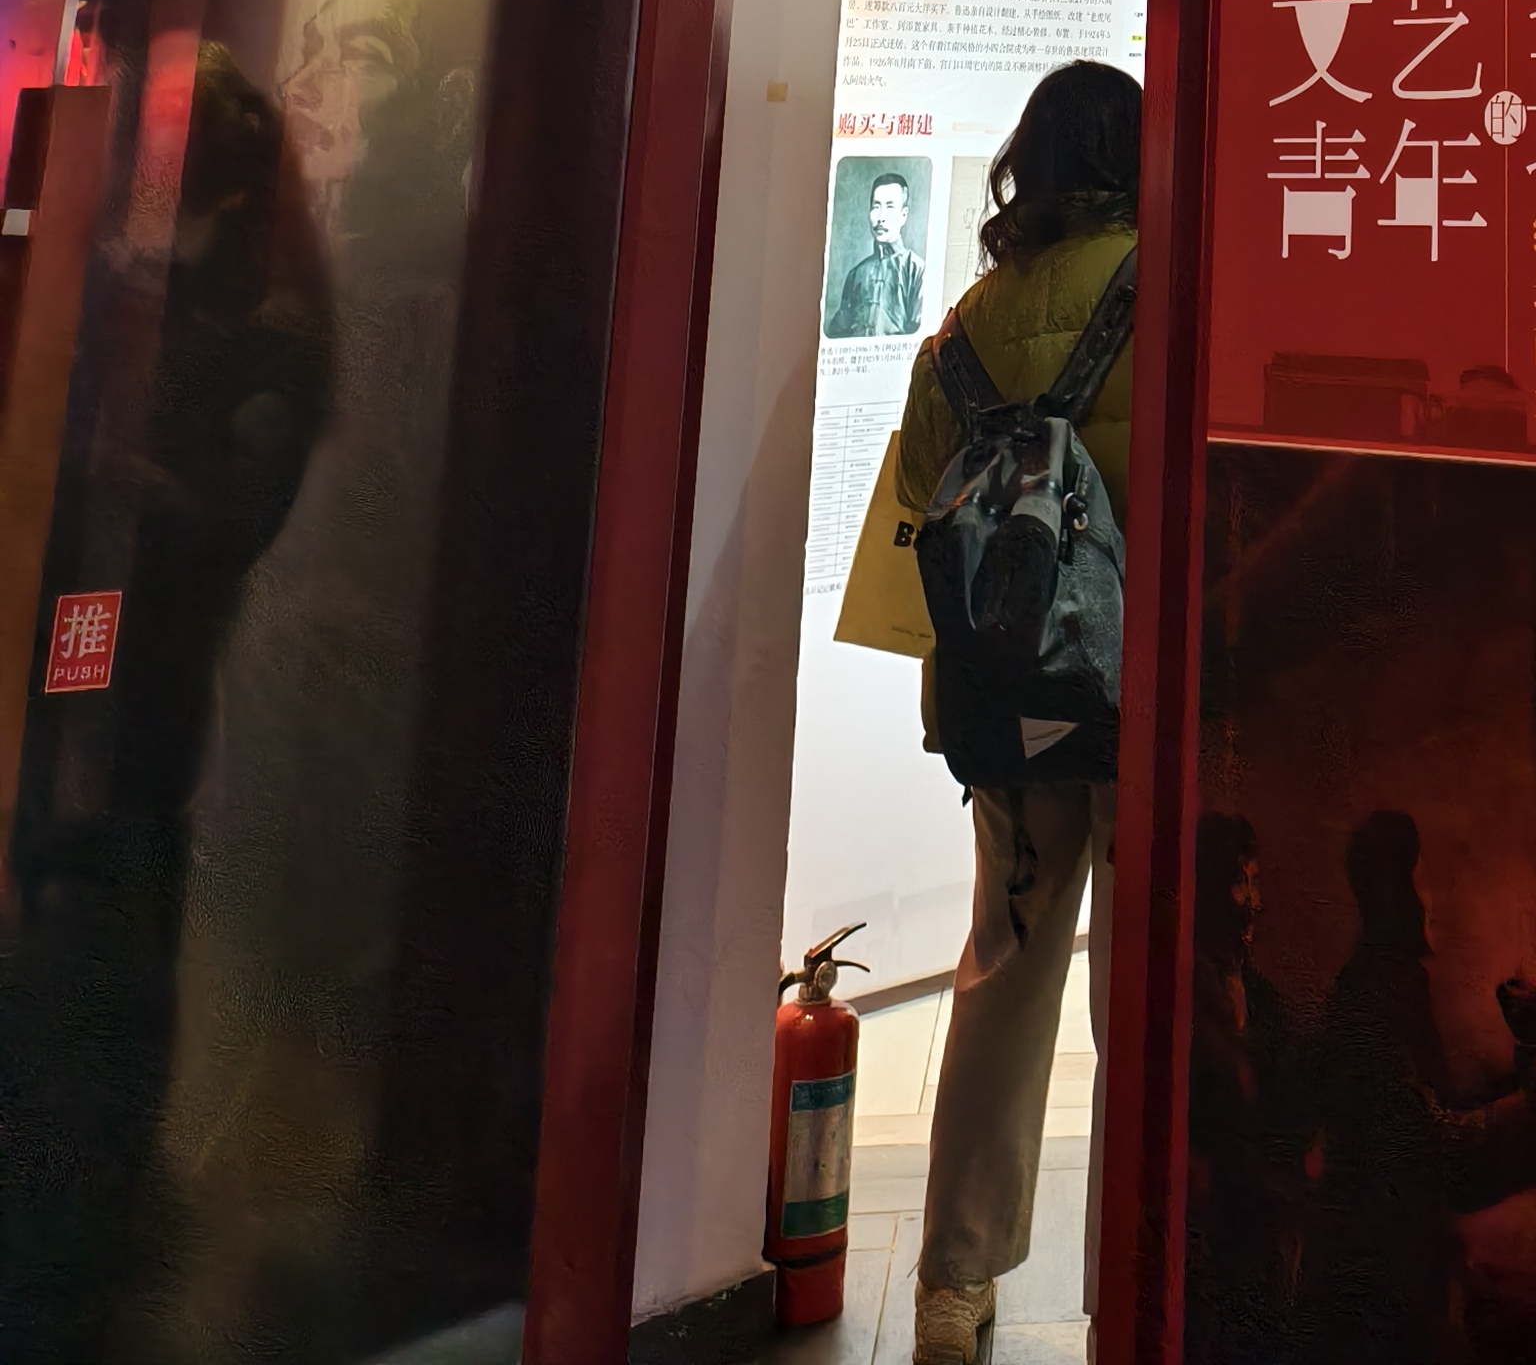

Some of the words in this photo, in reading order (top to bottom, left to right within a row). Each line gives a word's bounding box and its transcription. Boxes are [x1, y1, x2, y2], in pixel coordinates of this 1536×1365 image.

[838, 113, 933, 136] 购买与翻建
[1267, 118, 1487, 262] 青年
[61, 603, 112, 659] 推
[53, 664, 105, 681] PUSH
